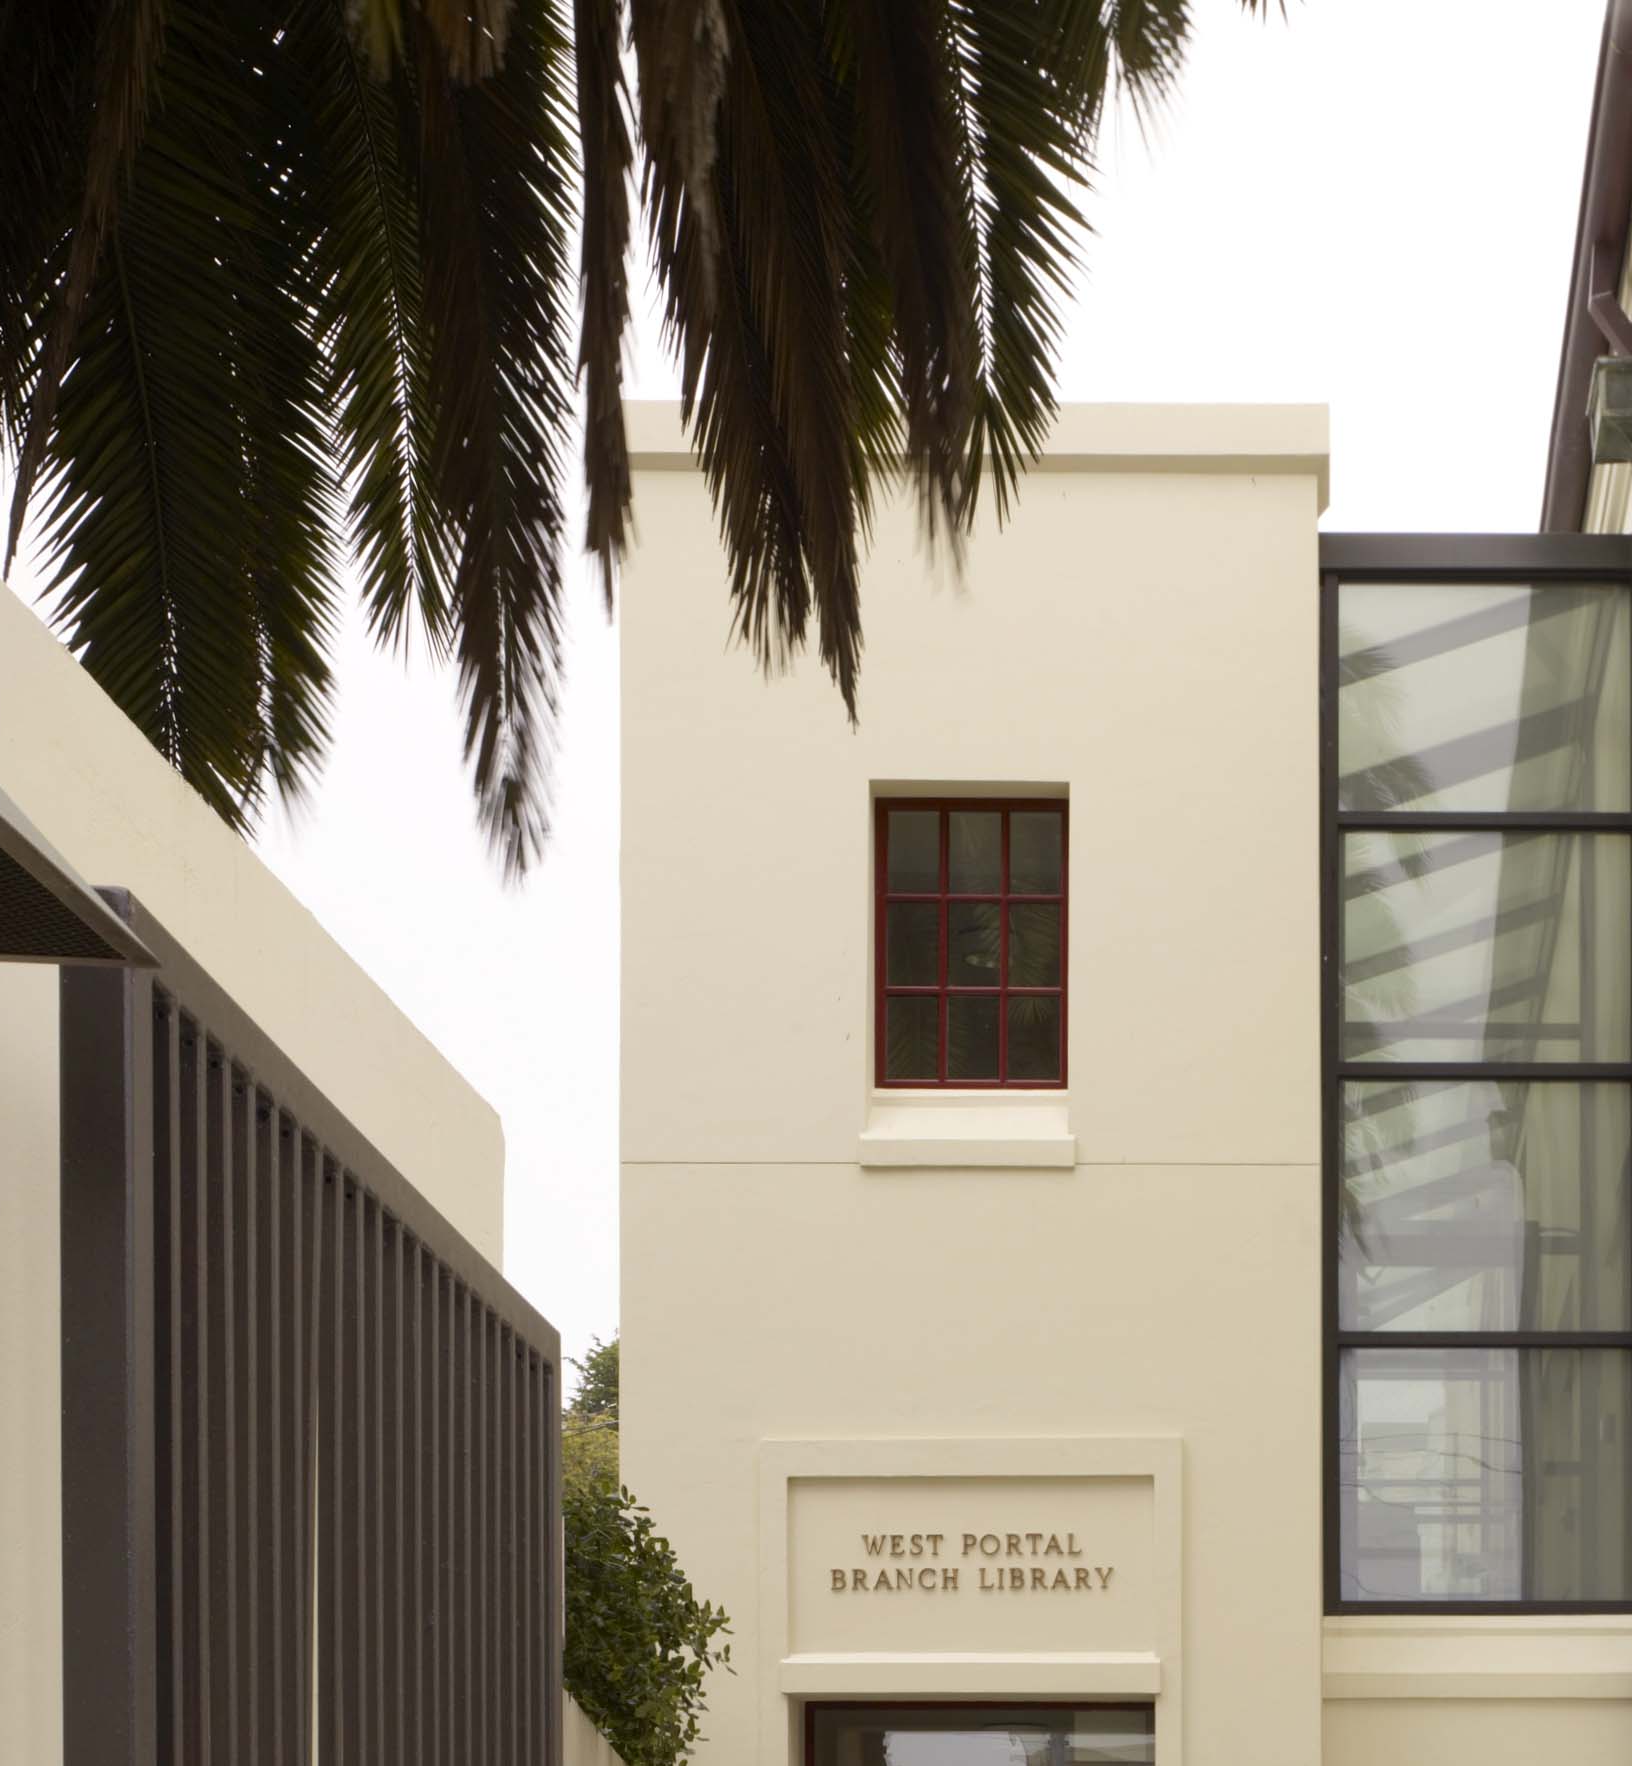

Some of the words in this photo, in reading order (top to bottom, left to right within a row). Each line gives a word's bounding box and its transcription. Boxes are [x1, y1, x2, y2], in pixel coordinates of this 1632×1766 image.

[861, 1533, 945, 1559] WEST
[961, 1532, 1083, 1558] PORTAL
[830, 1567, 961, 1595] BRANCH
[978, 1566, 1115, 1593] LIBRARY
